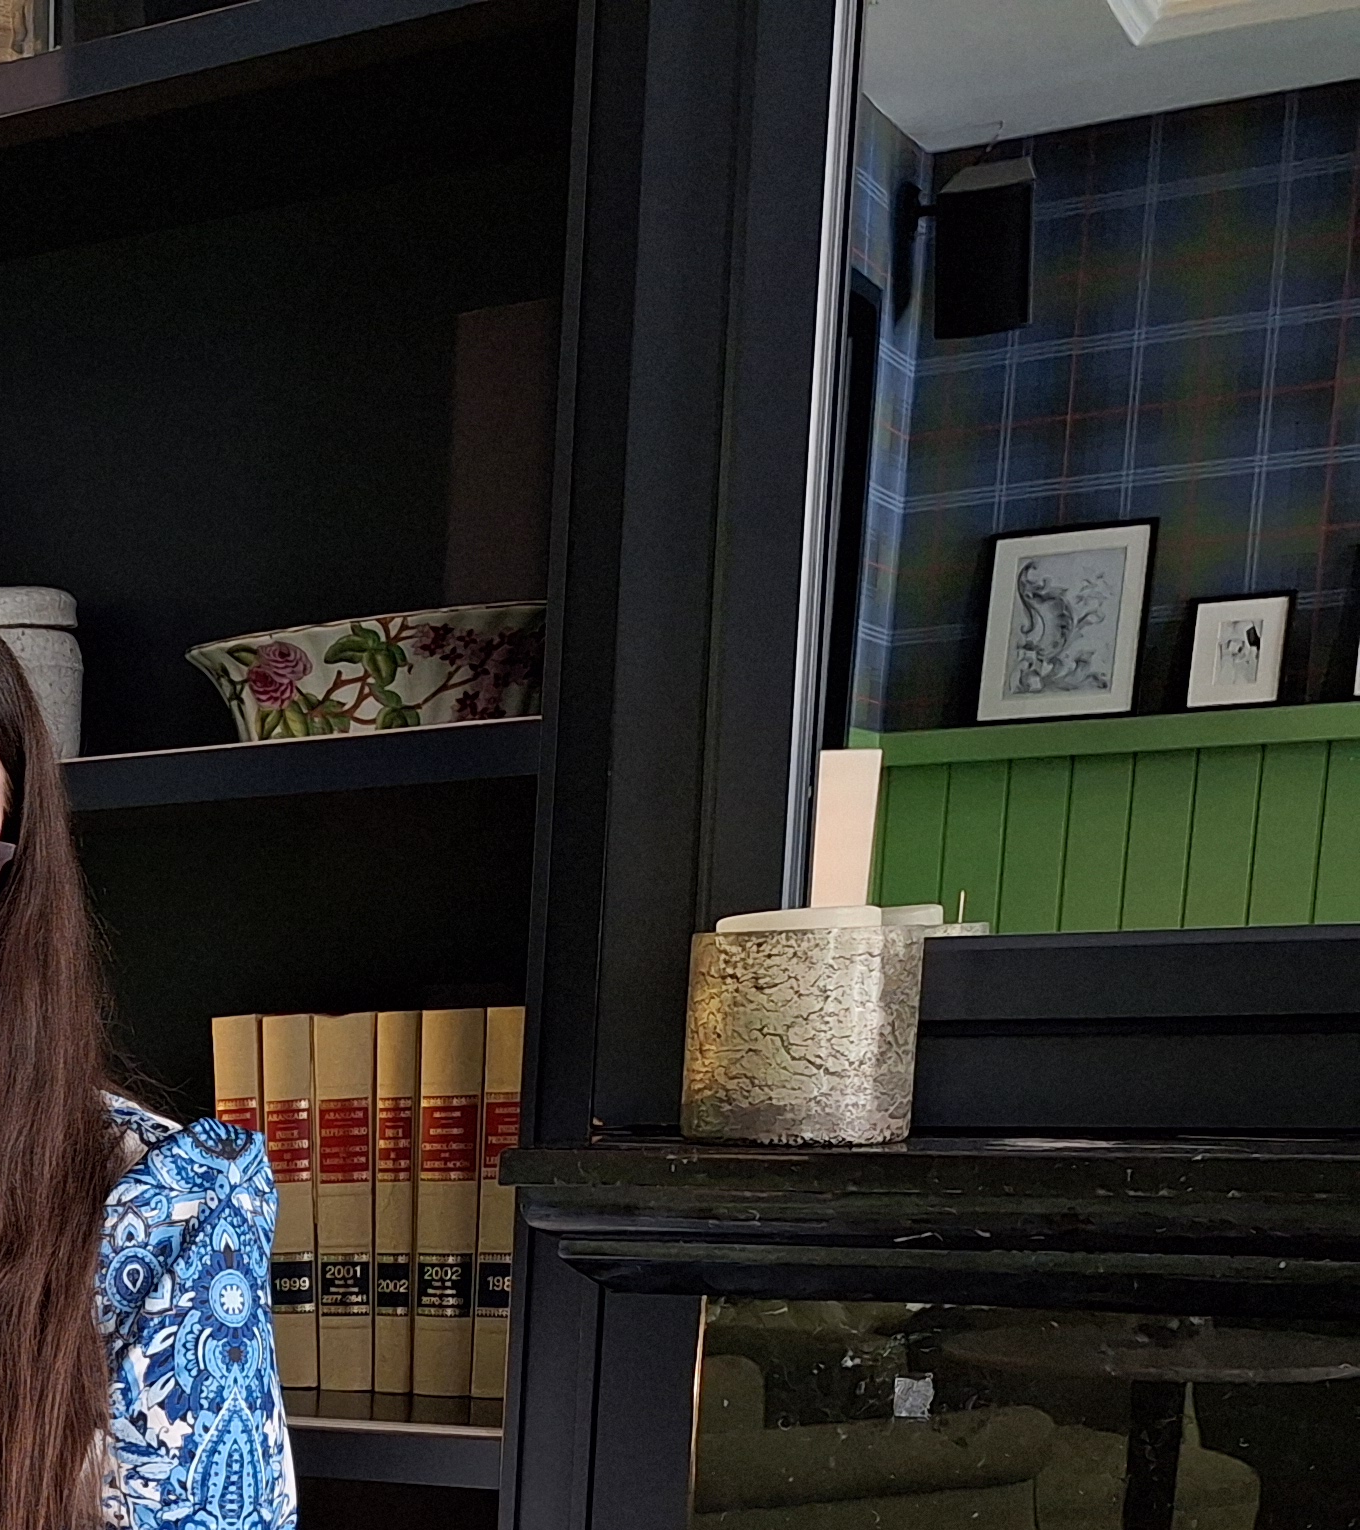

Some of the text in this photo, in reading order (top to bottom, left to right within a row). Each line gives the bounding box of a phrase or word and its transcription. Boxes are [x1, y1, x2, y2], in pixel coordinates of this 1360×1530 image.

[324, 1110, 364, 1119] ARANZADI
[321, 1127, 368, 1137] REPERTORIO
[325, 1265, 361, 1278] 2001
[424, 1266, 461, 1280] 2002
[274, 1276, 310, 1291] 1999
[378, 1279, 408, 1292] 2002
[487, 1276, 511, 1291] 198
